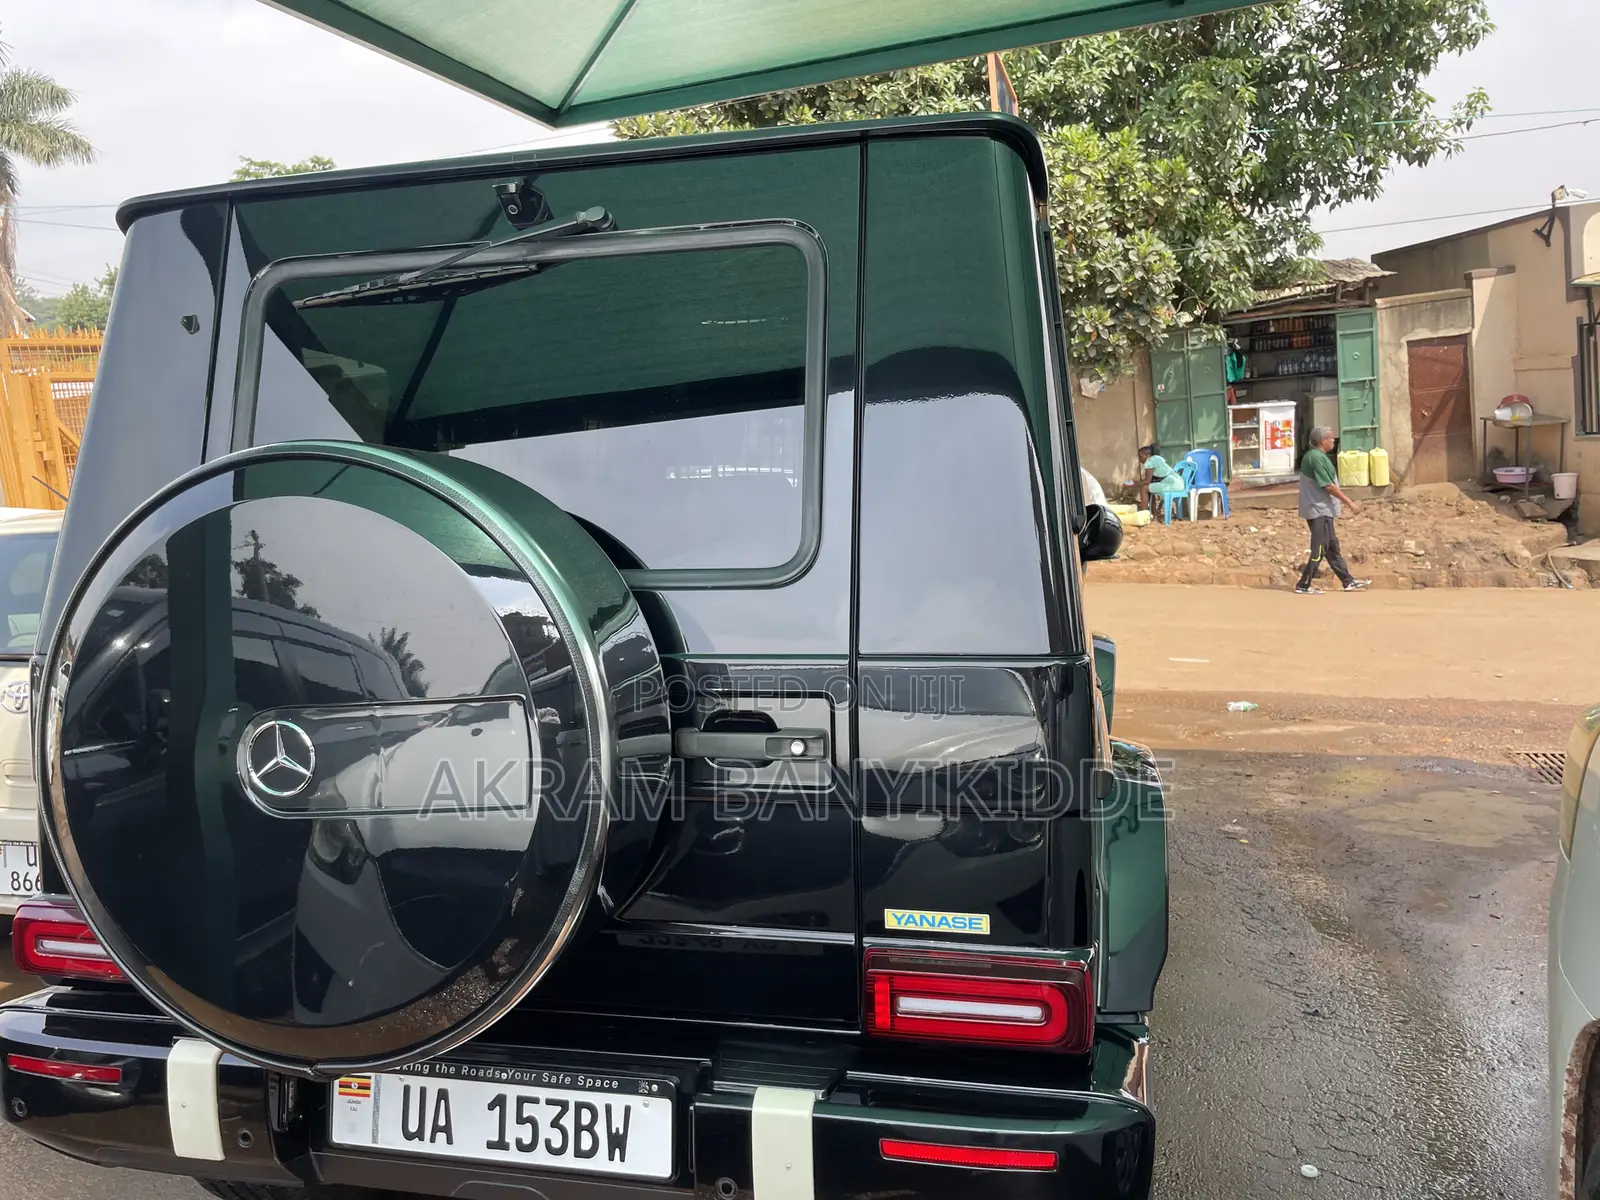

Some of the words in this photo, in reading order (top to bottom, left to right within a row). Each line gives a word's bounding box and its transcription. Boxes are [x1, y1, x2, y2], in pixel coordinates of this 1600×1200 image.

[891, 912, 984, 931] YANASE
[435, 1062, 456, 1075] the
[461, 1065, 501, 1079] Roads
[507, 1069, 537, 1081] Your
[541, 1072, 572, 1085] Safe
[577, 1075, 619, 1089] Space
[401, 1083, 454, 1146] UA
[486, 1092, 632, 1163] 153BW
